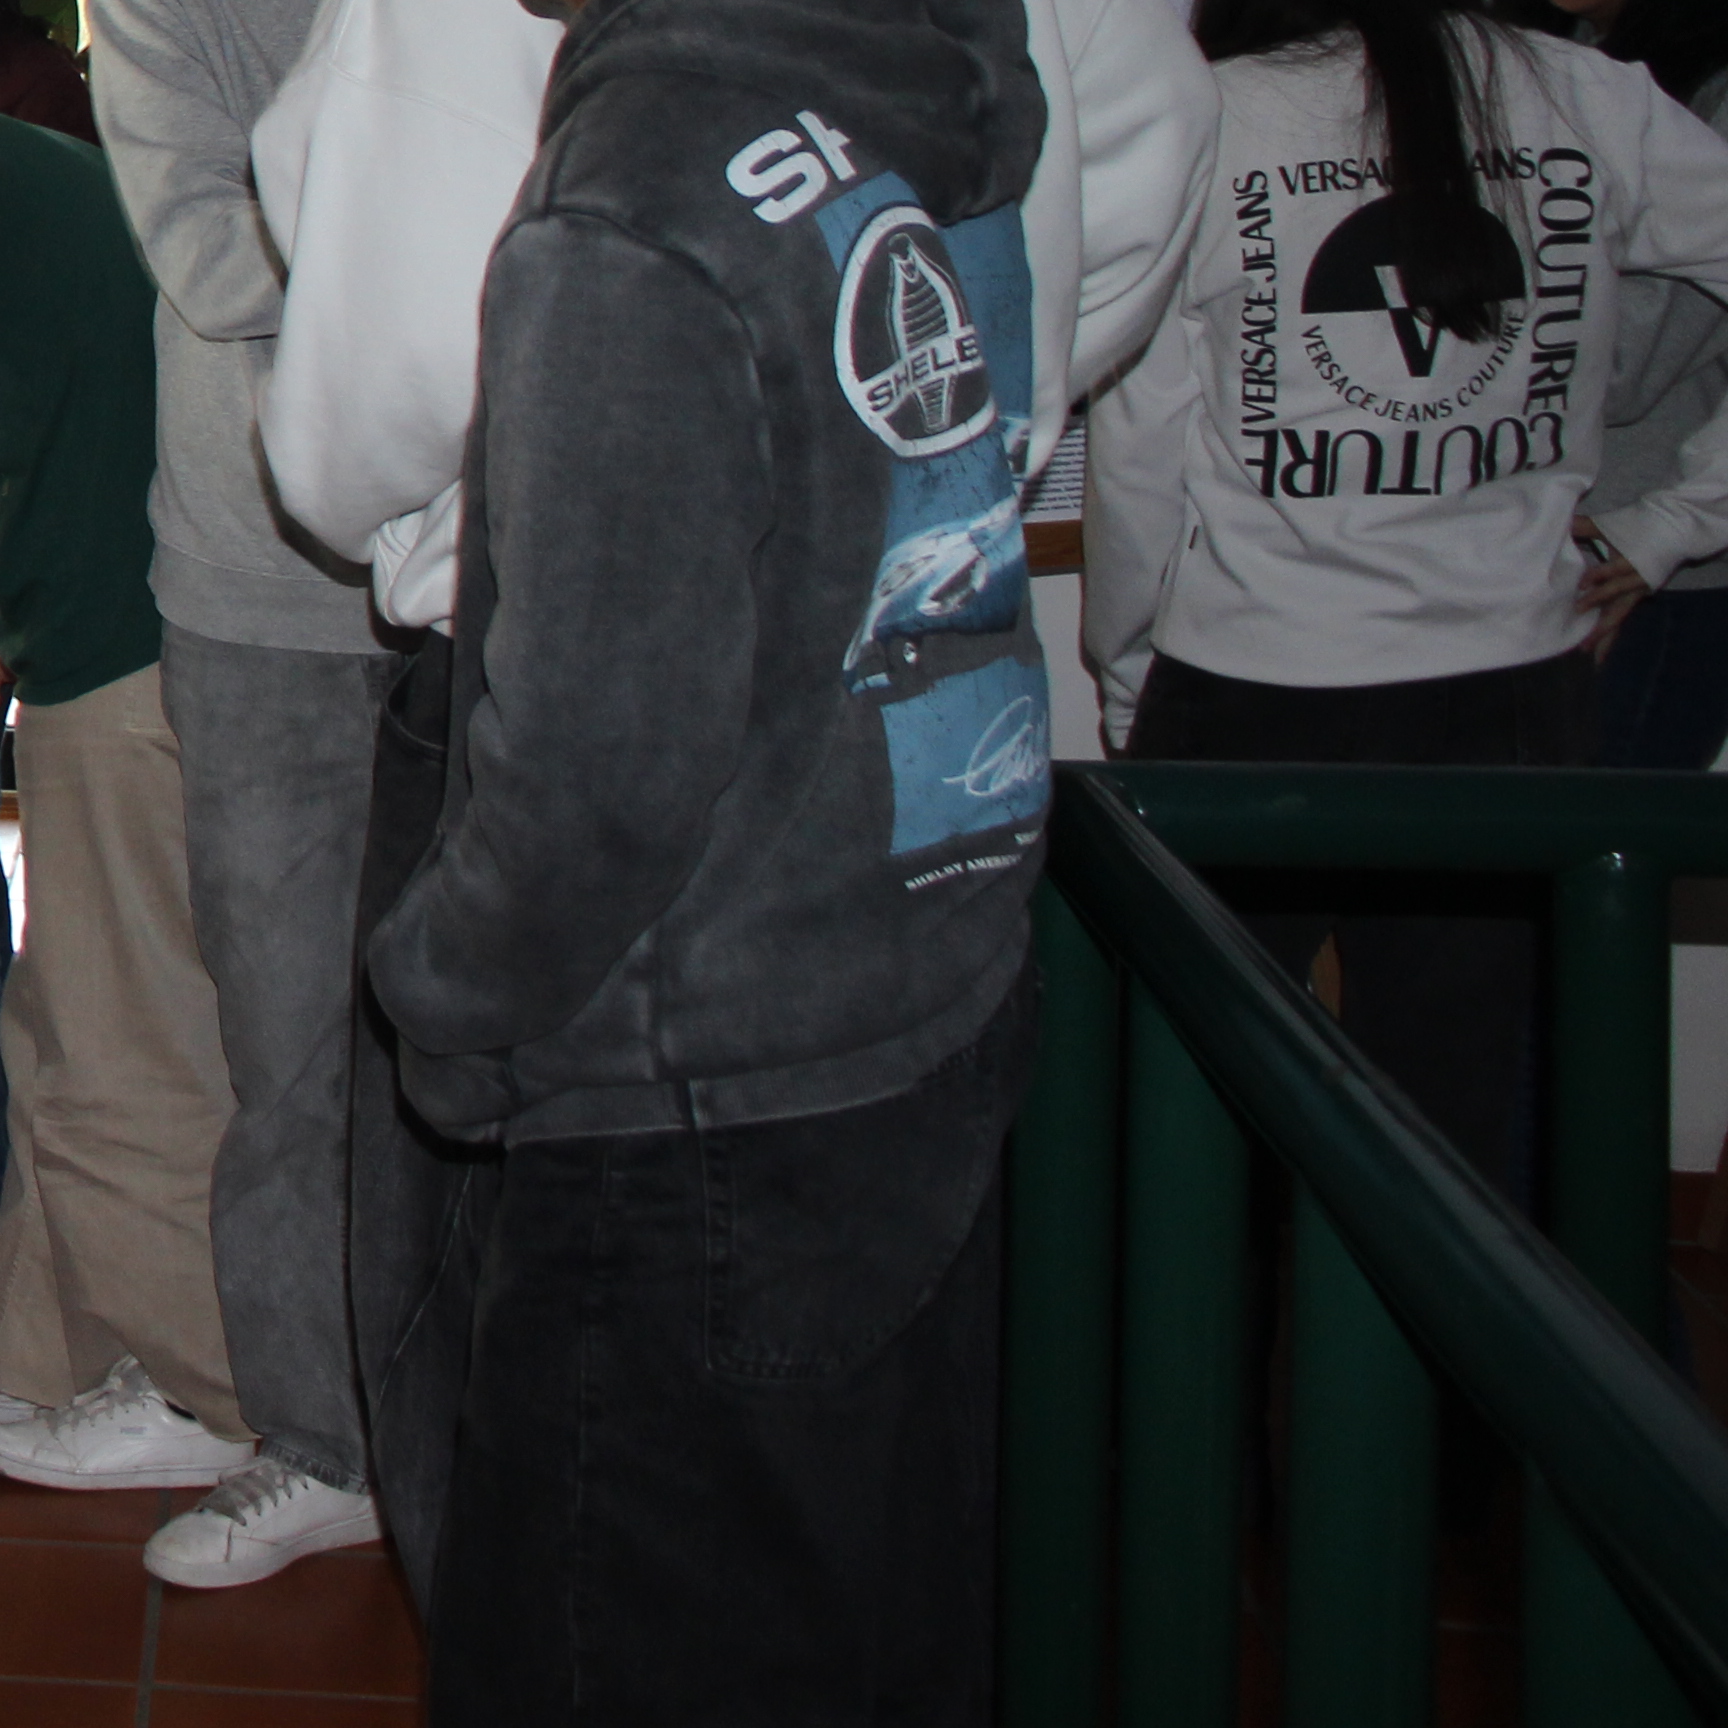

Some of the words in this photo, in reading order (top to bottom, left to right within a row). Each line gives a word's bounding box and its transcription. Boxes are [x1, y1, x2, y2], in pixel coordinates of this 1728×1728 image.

[1233, 169, 1277, 283] JEANS
[1278, 158, 1394, 196] VERSA
[1522, 147, 1595, 416] COUTURE
[1240, 288, 1277, 425] VERSACE
[1301, 324, 1378, 412] VERSACE
[1374, 397, 1453, 423] JEANS
[1456, 310, 1526, 408] COUTURE
[1240, 410, 1565, 499] COUTURE
